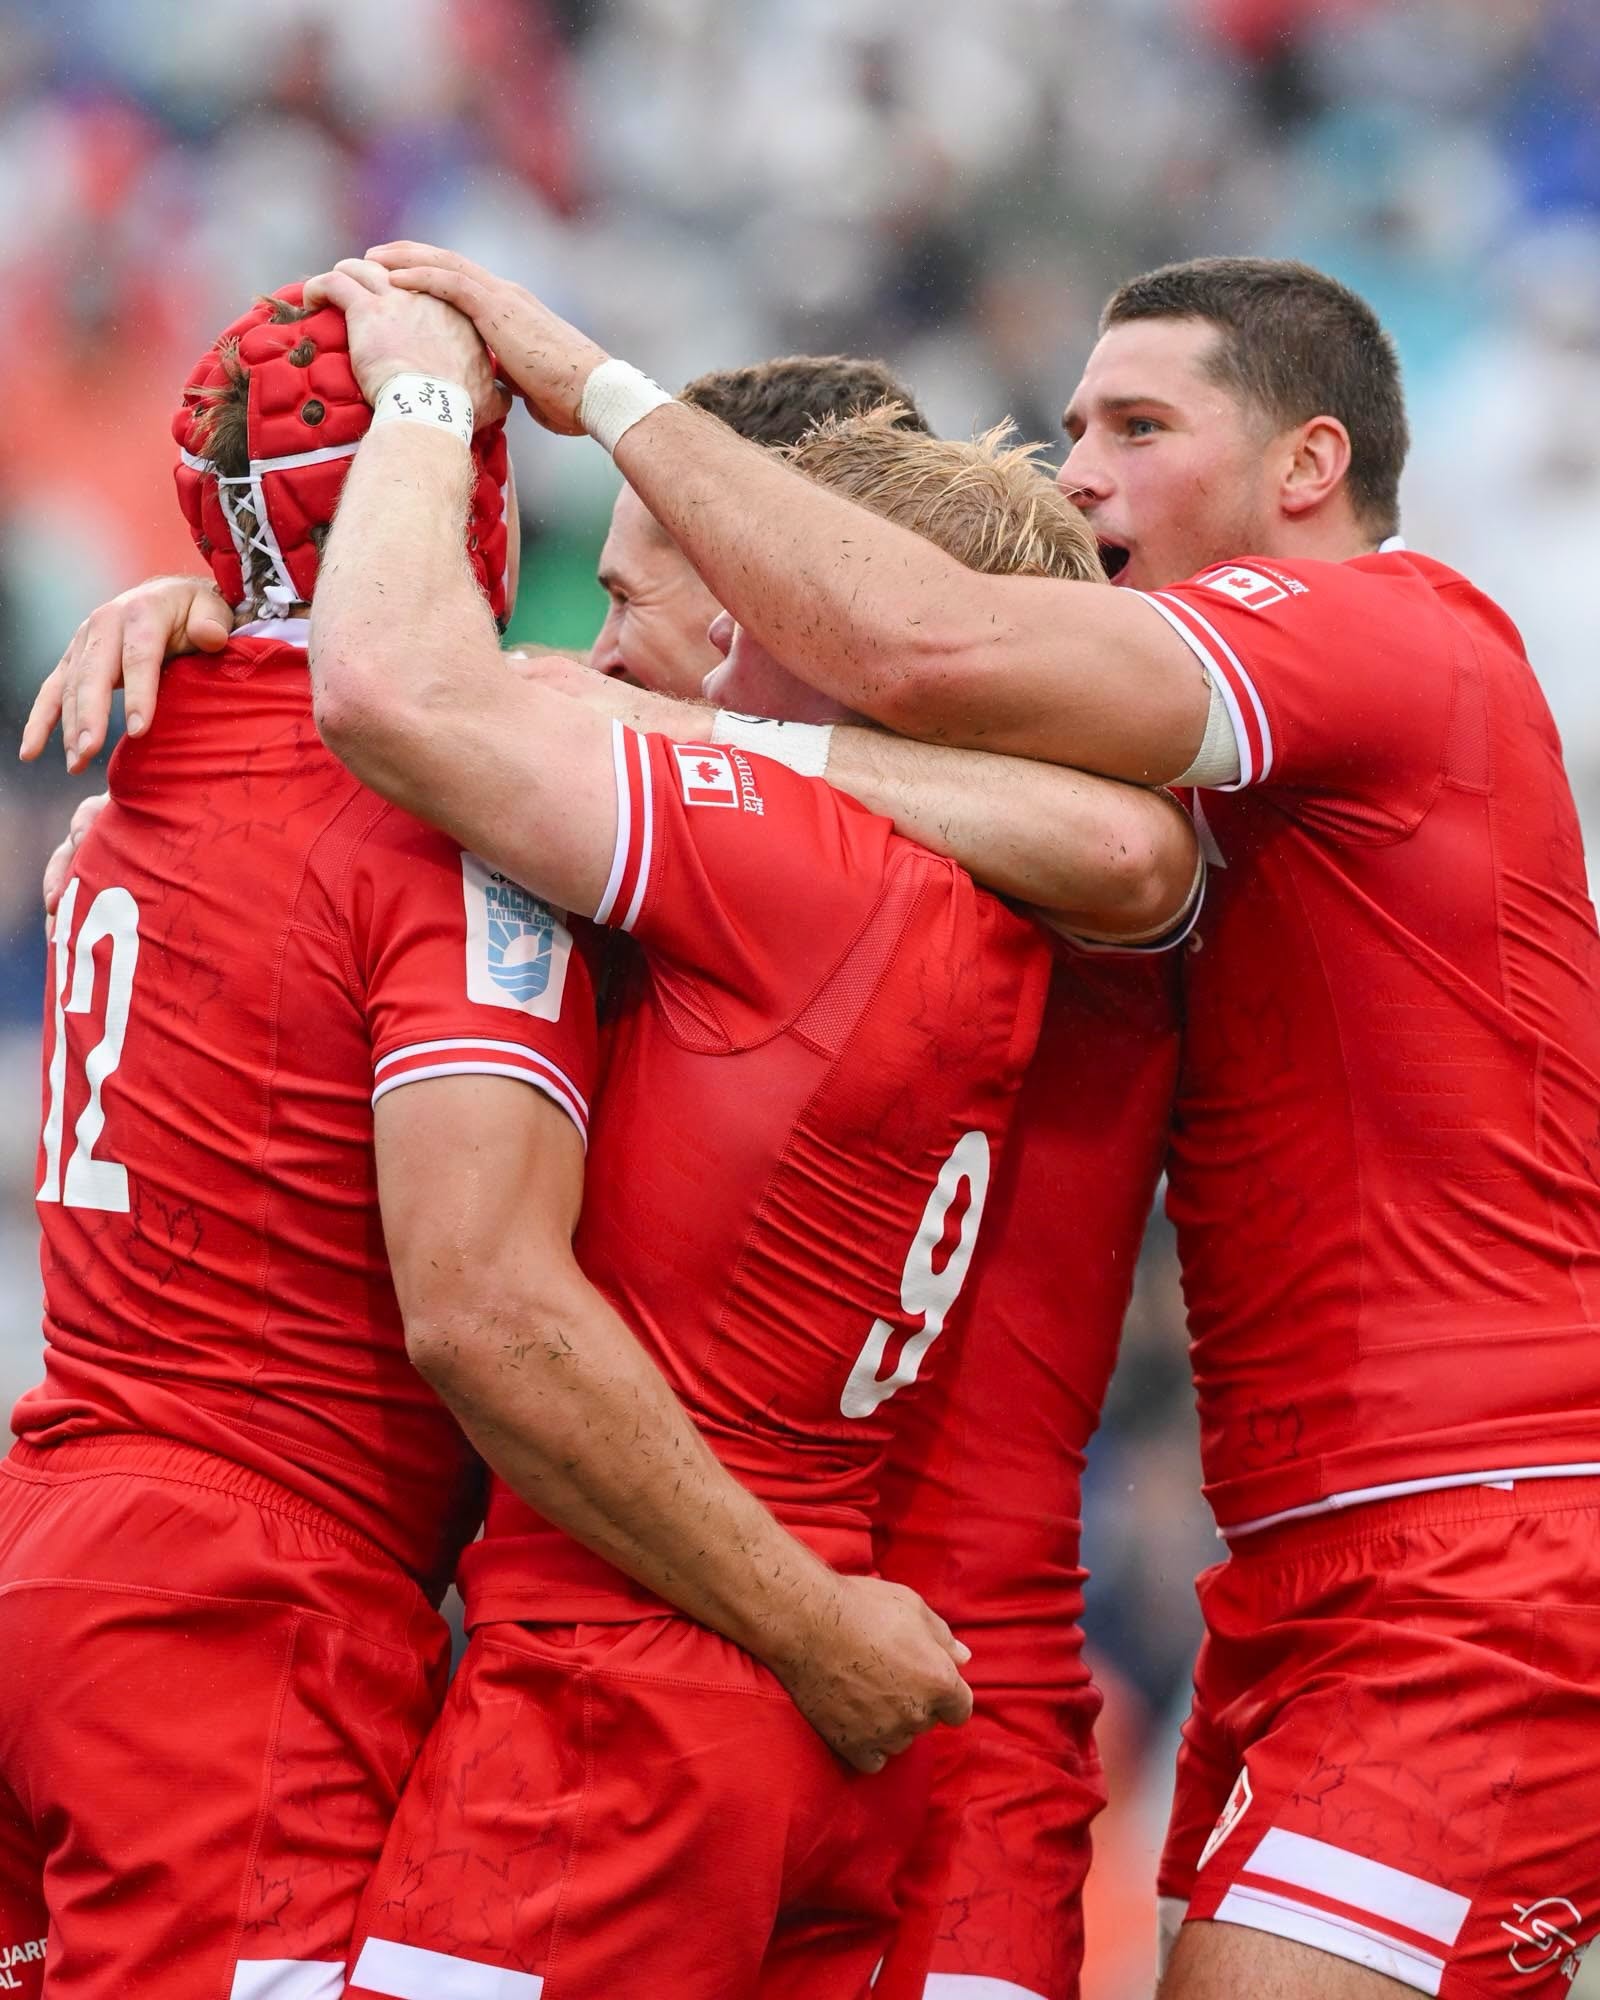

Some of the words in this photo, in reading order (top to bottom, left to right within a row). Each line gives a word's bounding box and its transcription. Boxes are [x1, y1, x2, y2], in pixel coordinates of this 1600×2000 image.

[35, 876, 139, 1213] 12
[487, 907, 532, 924] NATIONS
[533, 913, 556, 928] CUP
[840, 1130, 990, 1418] 9
